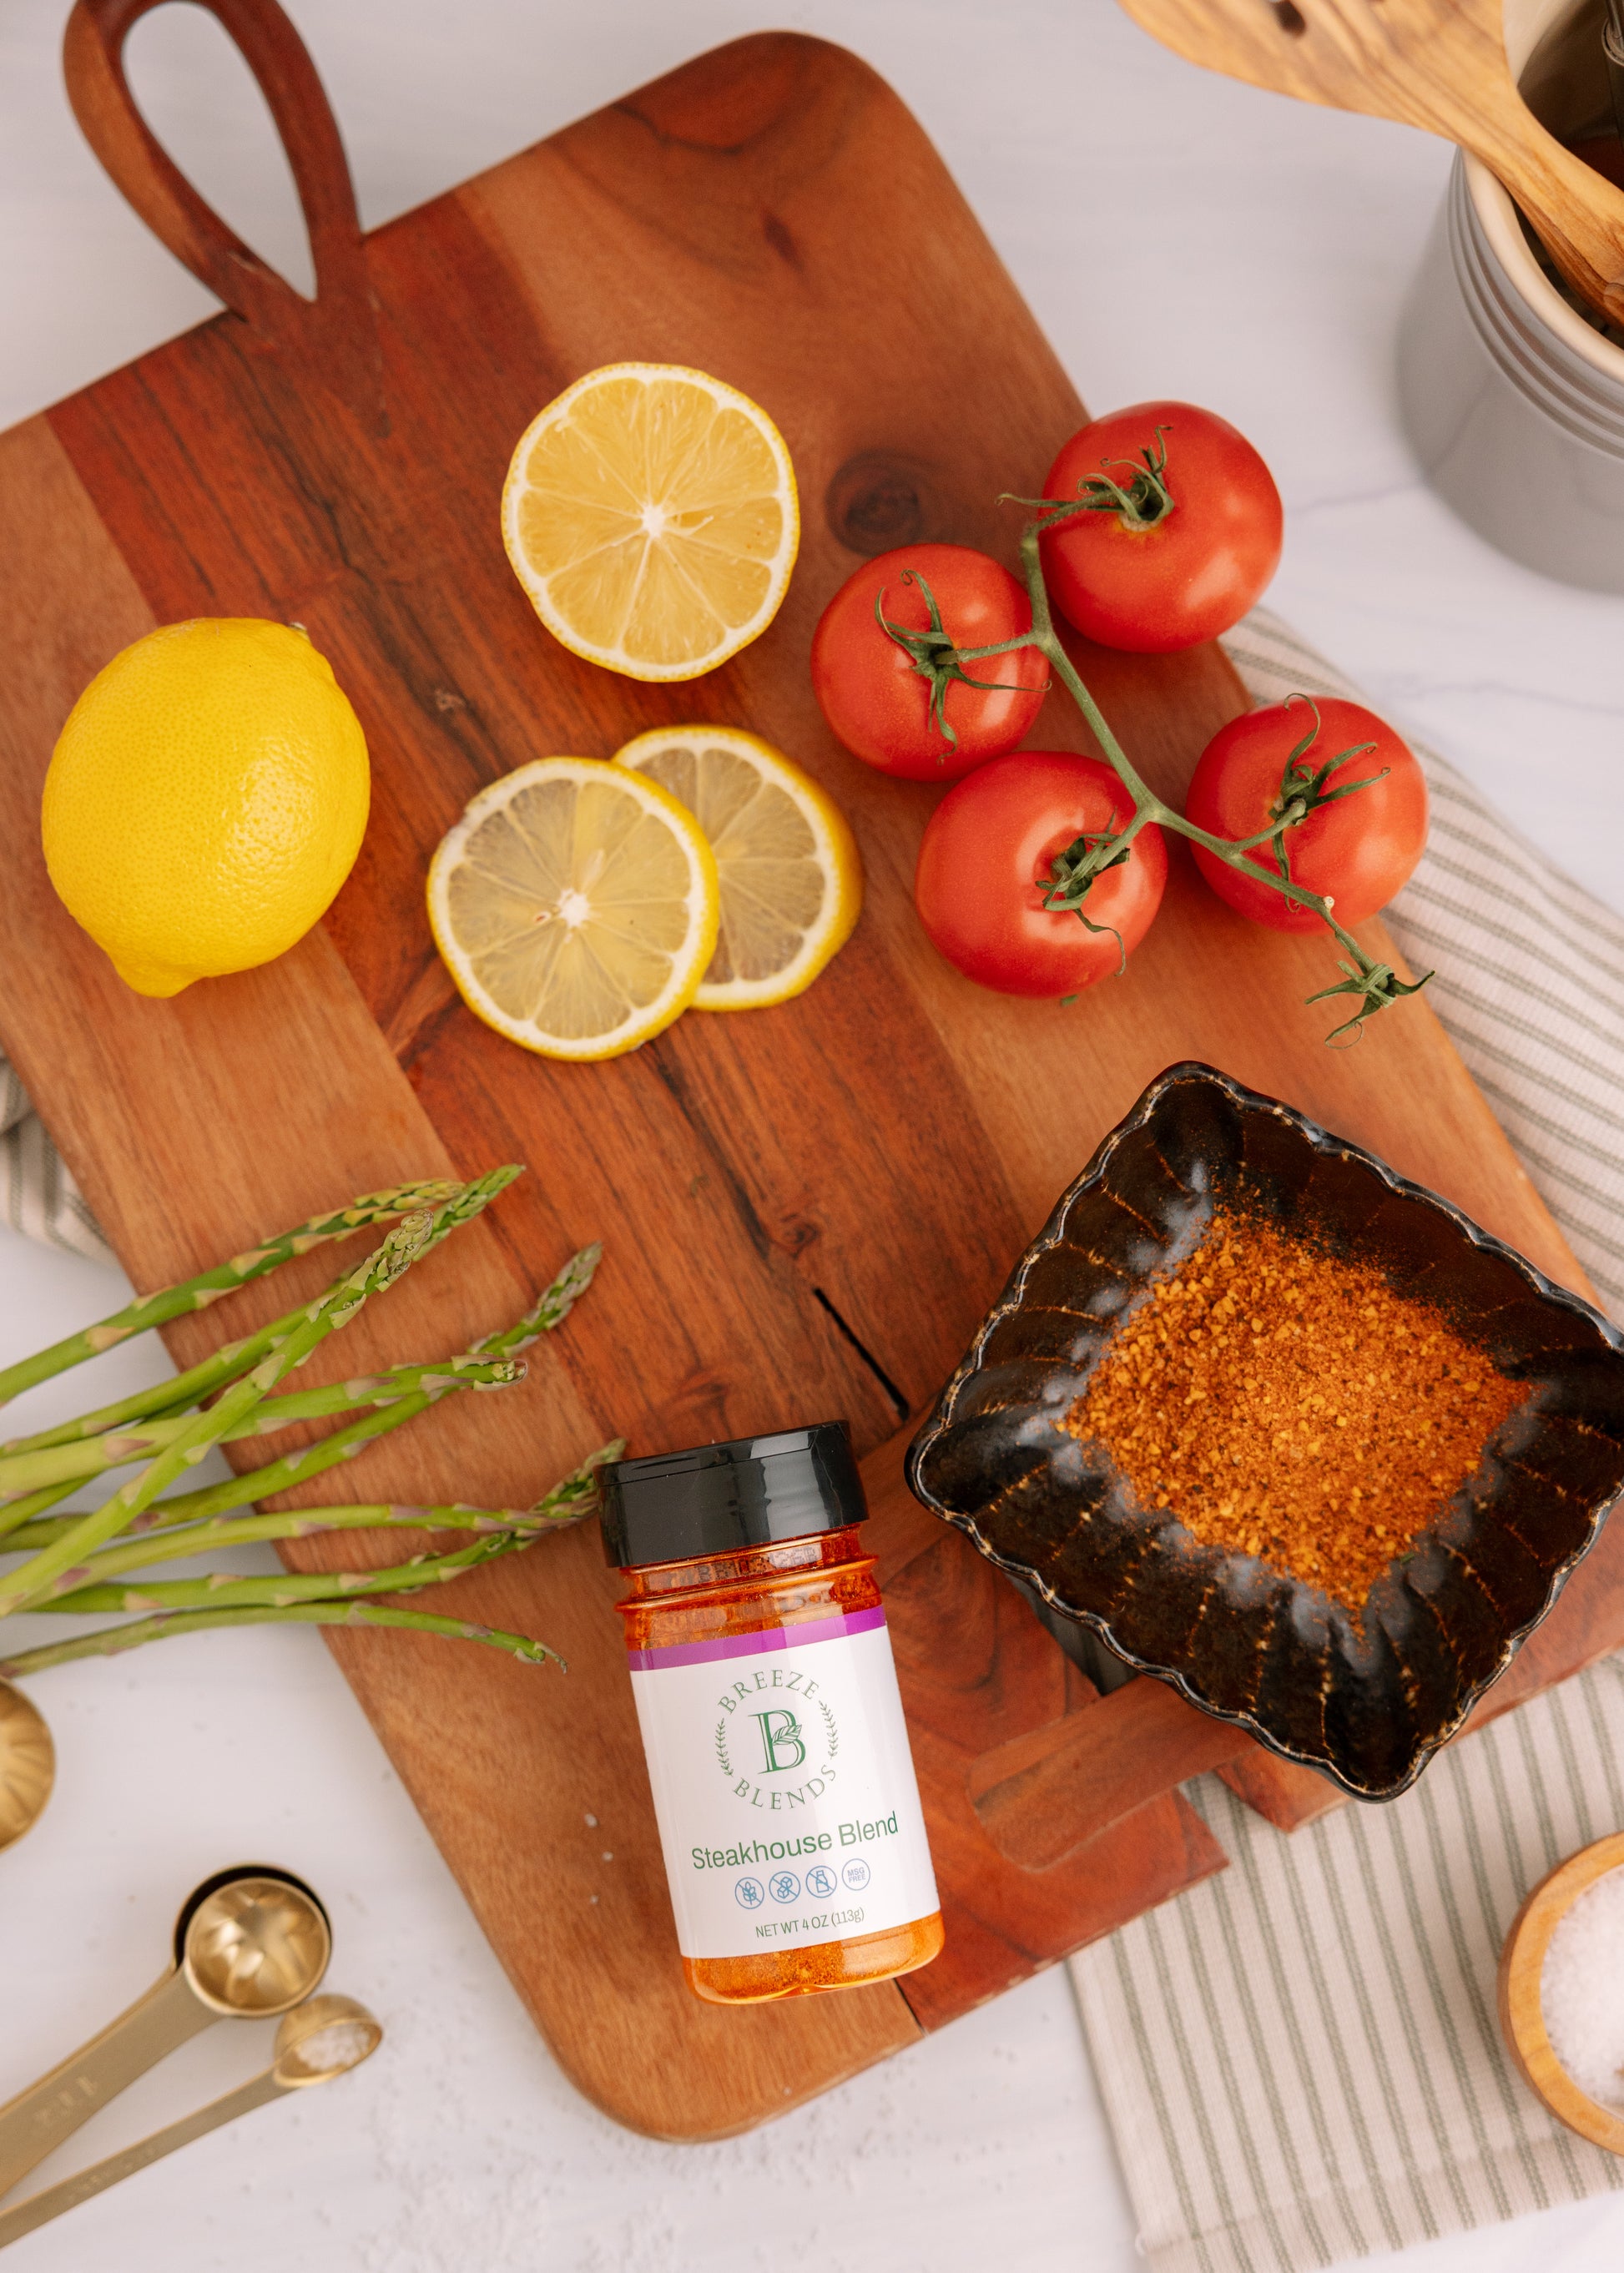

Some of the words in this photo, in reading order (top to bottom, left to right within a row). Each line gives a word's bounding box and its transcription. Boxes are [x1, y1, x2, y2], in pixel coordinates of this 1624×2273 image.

[718, 1669, 820, 1715] BREEZE
[732, 1764, 836, 1810] BLENDS
[692, 1832, 833, 1869] Steakhouse
[838, 1810, 899, 1847] Blend
[847, 1867, 865, 1877] MSG
[848, 1873, 866, 1883] FREE
[755, 1923, 779, 1938] NET
[780, 1920, 799, 1935] WT
[802, 1918, 809, 1930] 4
[811, 1914, 830, 1929] OZ
[830, 1907, 865, 1928] (113g)
